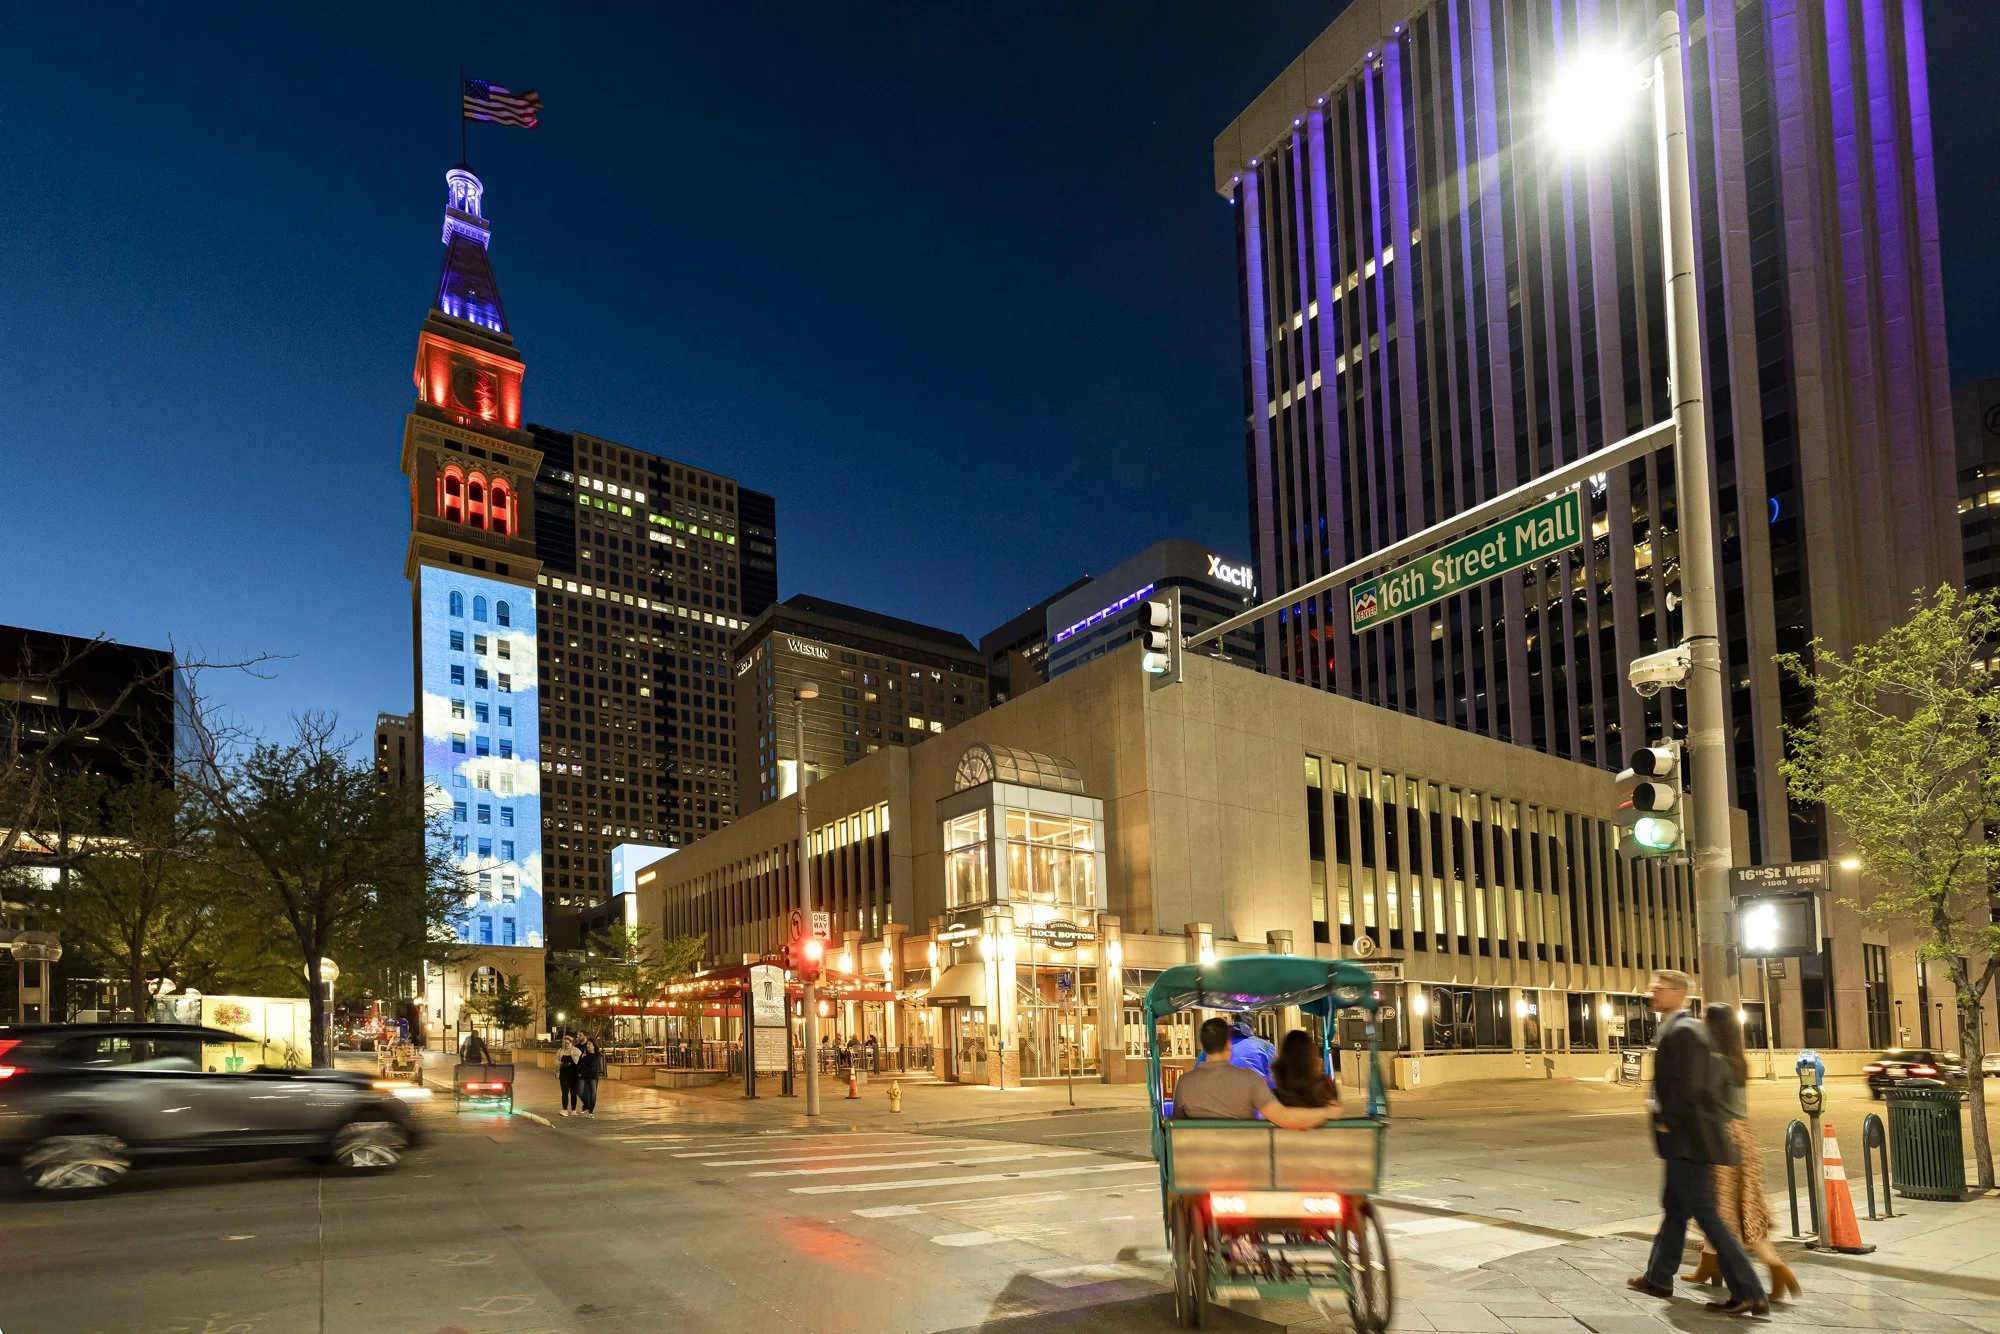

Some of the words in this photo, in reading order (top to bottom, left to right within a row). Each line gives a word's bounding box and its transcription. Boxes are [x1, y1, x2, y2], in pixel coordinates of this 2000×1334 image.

[1379, 569, 1425, 611] 16th
[1432, 531, 1508, 591] Street
[1515, 501, 1575, 557] Mall
[1356, 606, 1377, 621] DENVER
[1785, 864, 1820, 877] Mall
[813, 914, 827, 922] ONE
[813, 922, 828, 930] WAY
[1031, 929, 1057, 937] ROCK
[1058, 931, 1094, 939] BOTTOM
